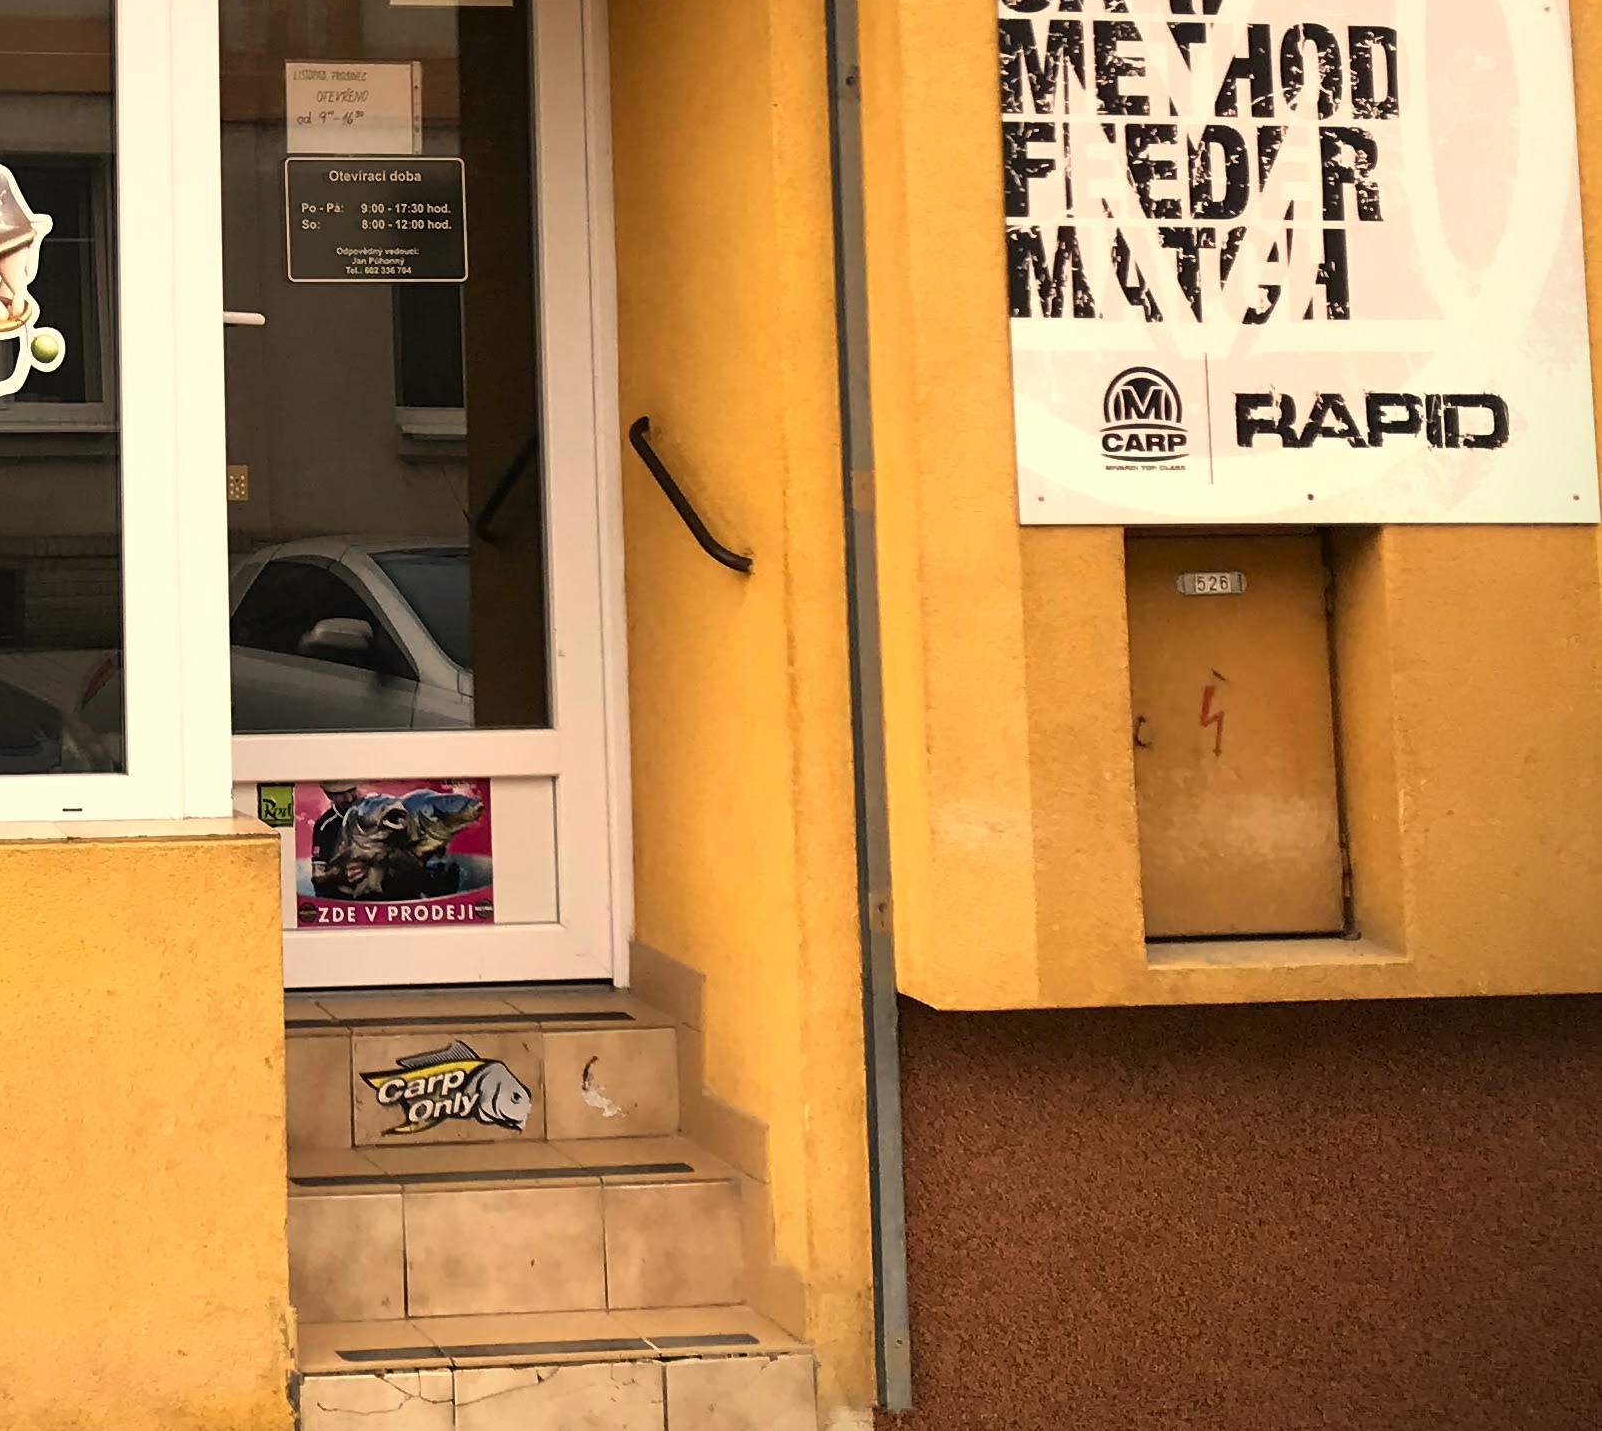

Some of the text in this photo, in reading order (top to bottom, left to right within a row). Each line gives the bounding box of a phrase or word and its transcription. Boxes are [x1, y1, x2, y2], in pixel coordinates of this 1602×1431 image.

[999, 18, 1400, 122] METHOD
[297, 111, 312, 125] od
[329, 170, 422, 182] Otevírací doba
[301, 203, 317, 213] Po
[326, 202, 344, 213] Pá:
[361, 203, 385, 214] 9:00
[395, 203, 424, 214] 17:30
[427, 203, 451, 214] hod.
[301, 219, 320, 230] So:
[362, 220, 385, 230] 8:00
[395, 220, 424, 230] 12:00
[427, 219, 452, 230] hod.
[352, 257, 367, 265] Jan
[1234, 389, 1510, 449] RAPID
[1101, 433, 1188, 453] CARP
[1197, 575, 1230, 593] 526
[318, 906, 356, 923] ZDE
[365, 906, 378, 922] V
[387, 904, 474, 921] PRODEJI
[376, 1071, 466, 1106] Carp
[407, 1090, 481, 1123] Only
